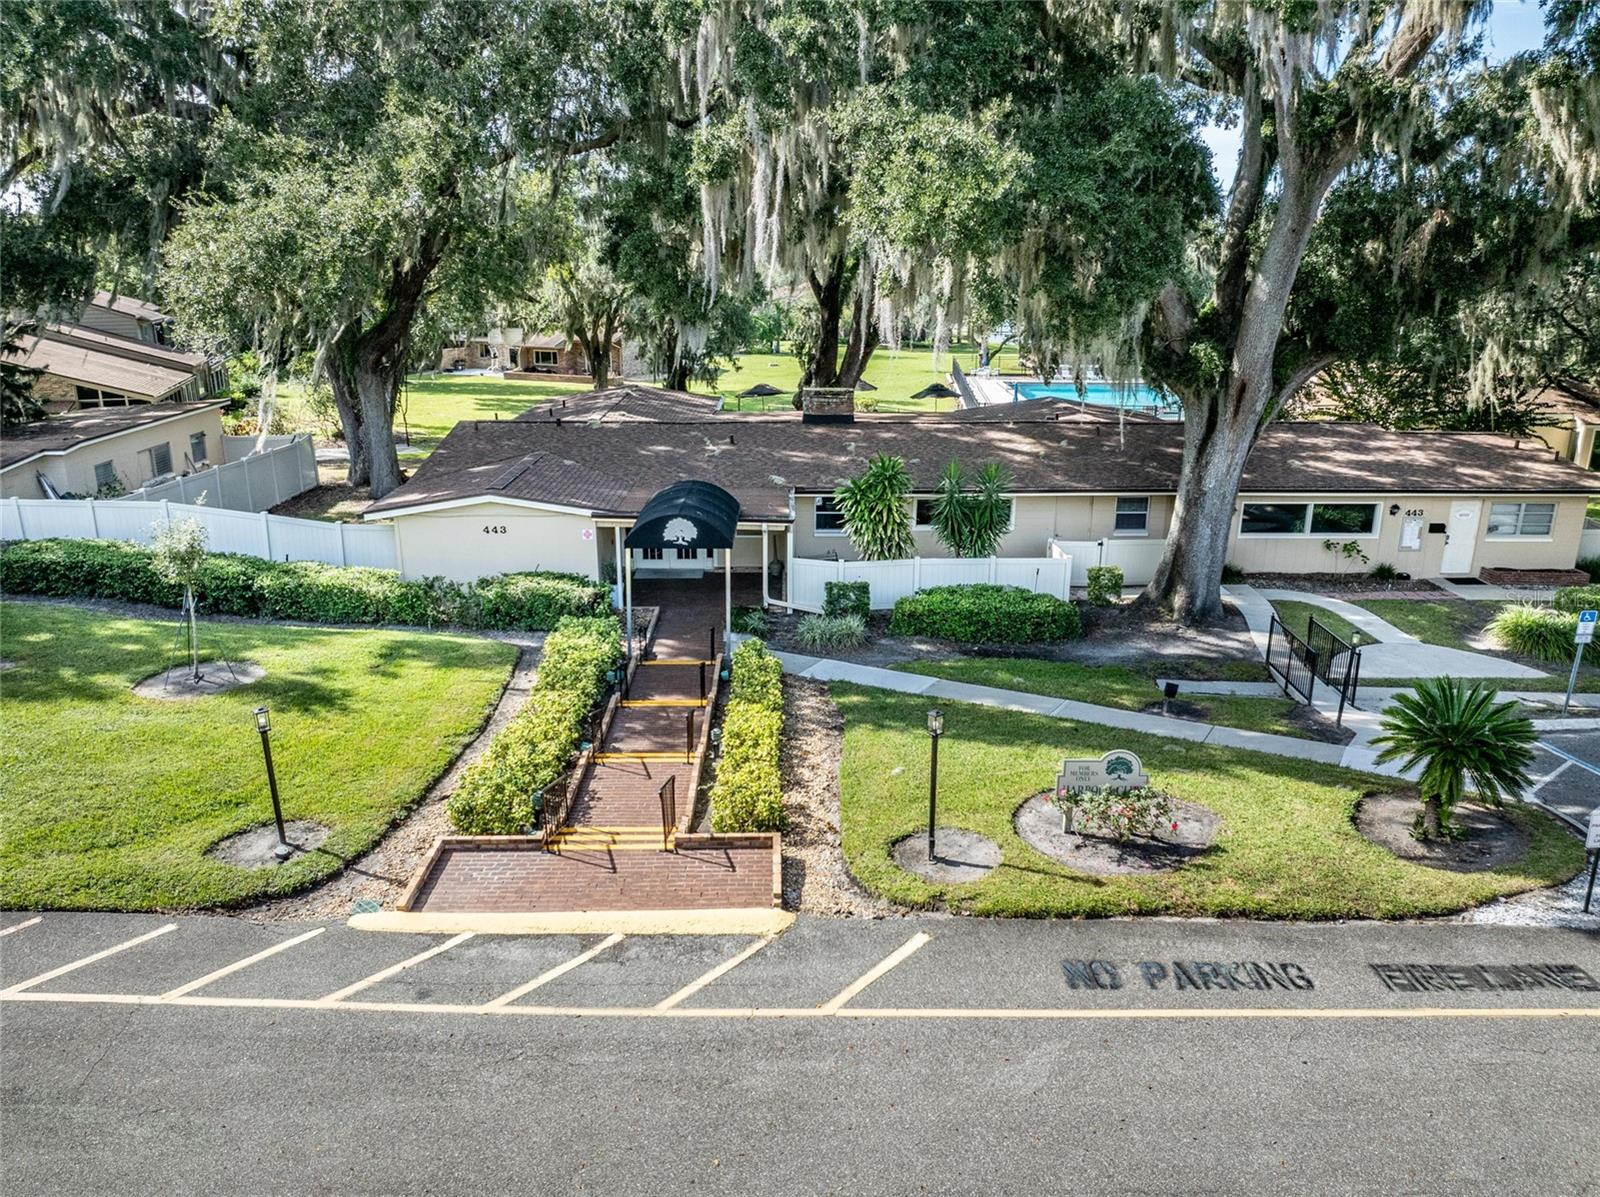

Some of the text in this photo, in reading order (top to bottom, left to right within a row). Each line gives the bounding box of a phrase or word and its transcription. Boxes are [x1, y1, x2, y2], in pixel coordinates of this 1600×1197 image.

[1405, 509, 1424, 517] 443
[482, 525, 507, 534] 443
[1061, 959, 1315, 991] NO PARKING
